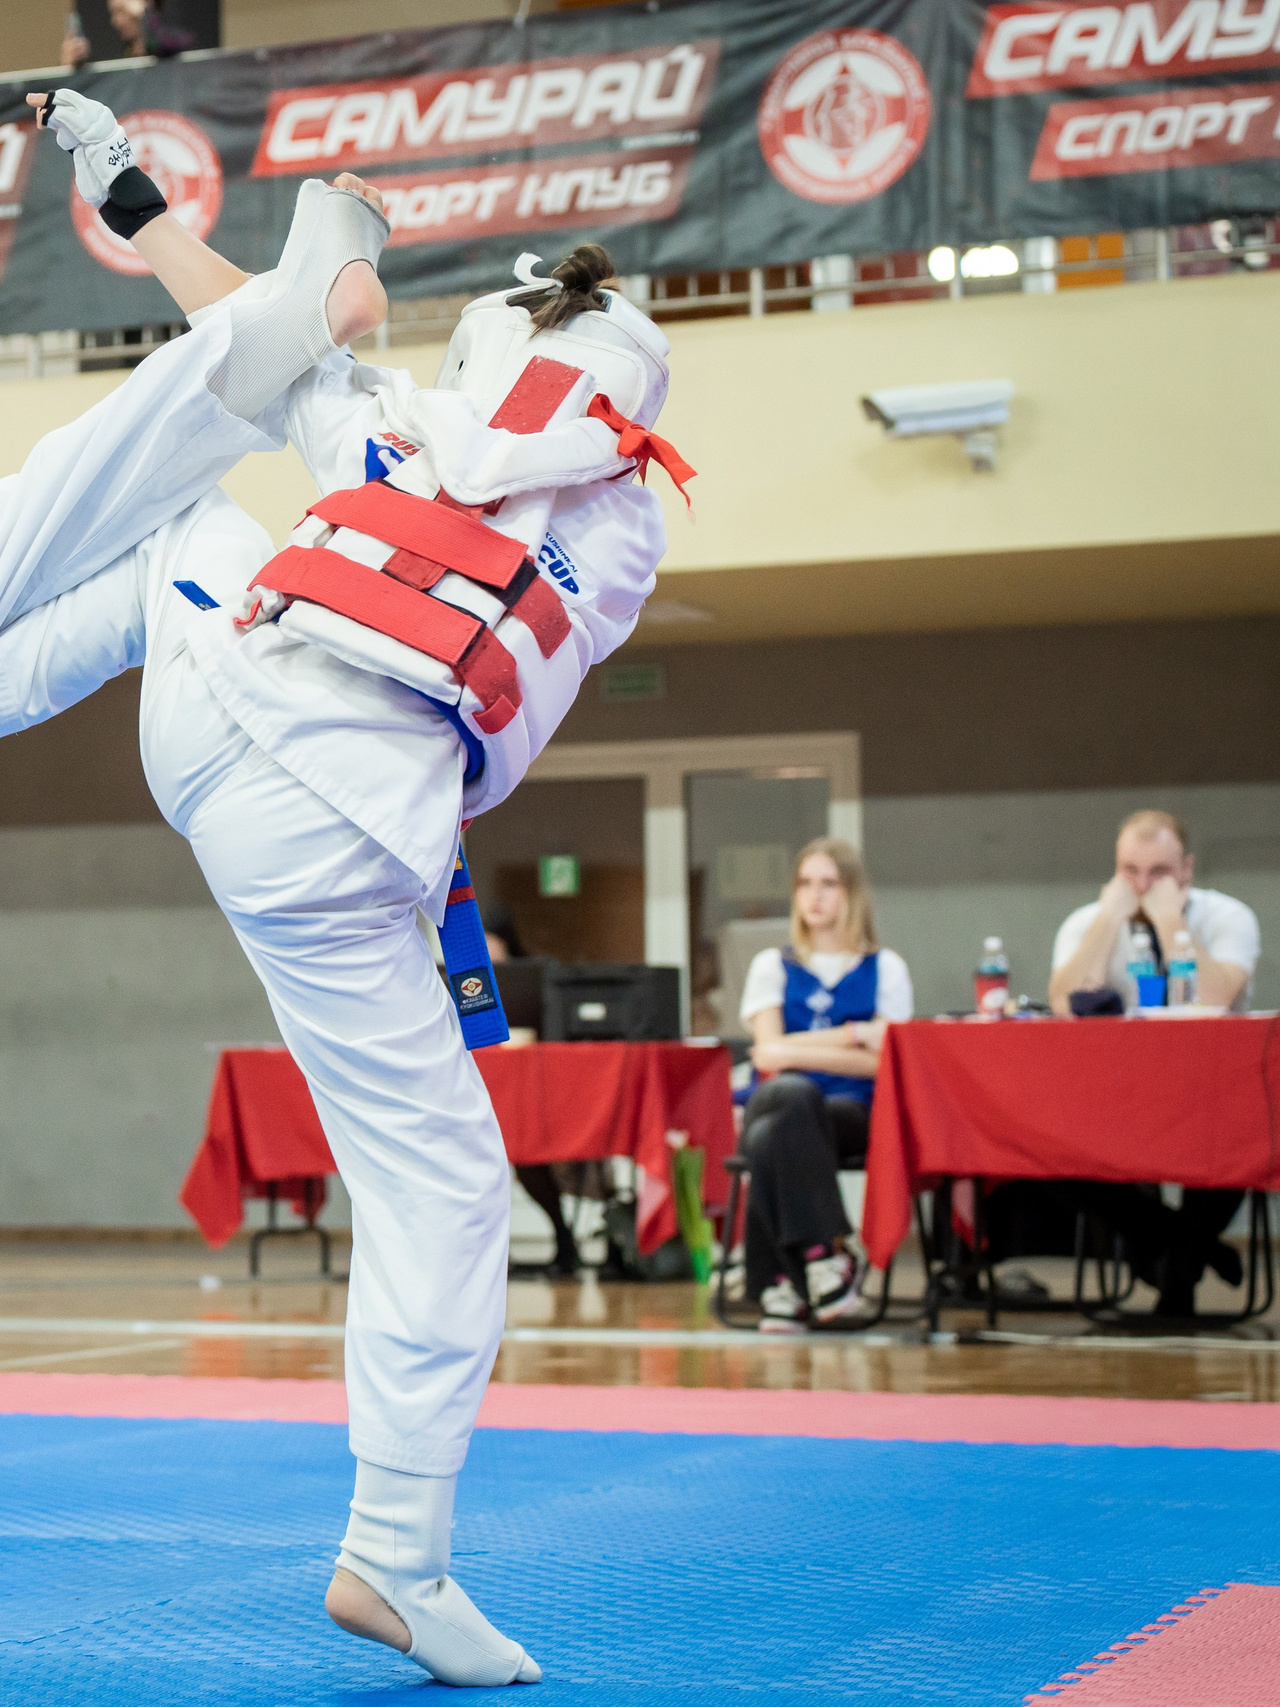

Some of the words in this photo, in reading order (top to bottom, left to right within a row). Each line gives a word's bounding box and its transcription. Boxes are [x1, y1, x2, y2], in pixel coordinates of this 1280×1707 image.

[983, 0, 1280, 80] САМУ
[266, 43, 705, 162] САМУРАЙ
[1055, 96, 1273, 161] СПОРТ
[381, 175, 517, 232] ПОРТ
[538, 544, 580, 595] CUP
